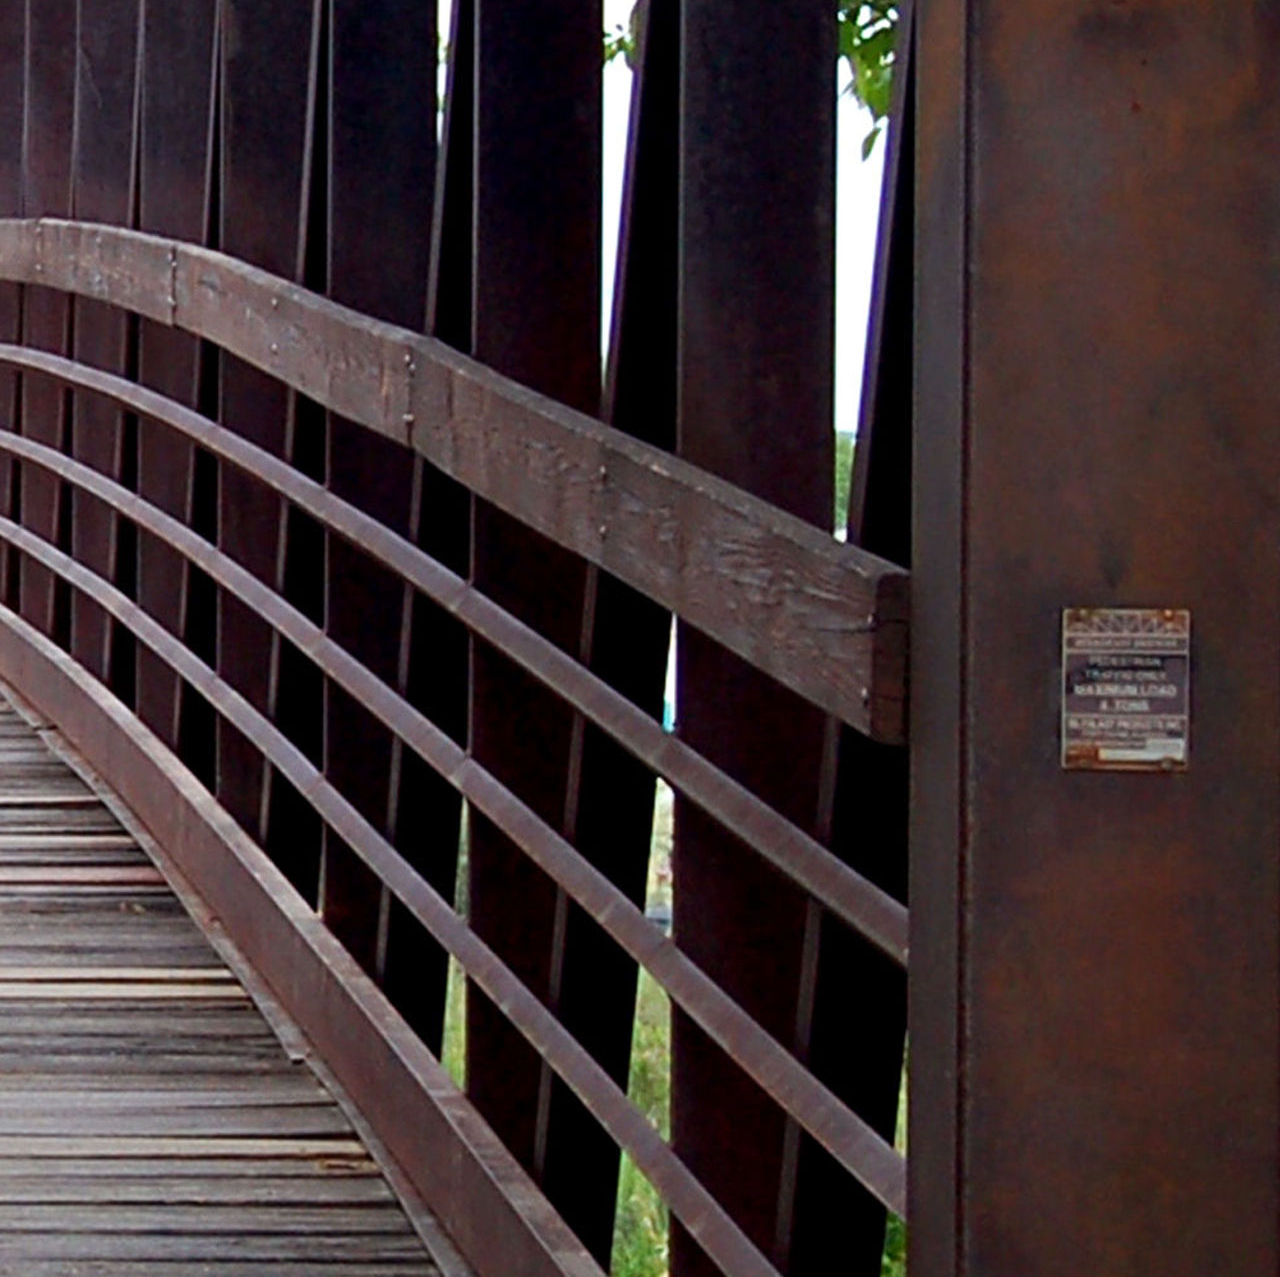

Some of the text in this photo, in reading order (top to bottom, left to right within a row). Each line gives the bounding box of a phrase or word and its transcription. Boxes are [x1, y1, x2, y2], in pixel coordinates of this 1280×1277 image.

[1074, 684, 1178, 697] MAXIMUM LOAD
[1115, 699, 1150, 712] TONS
